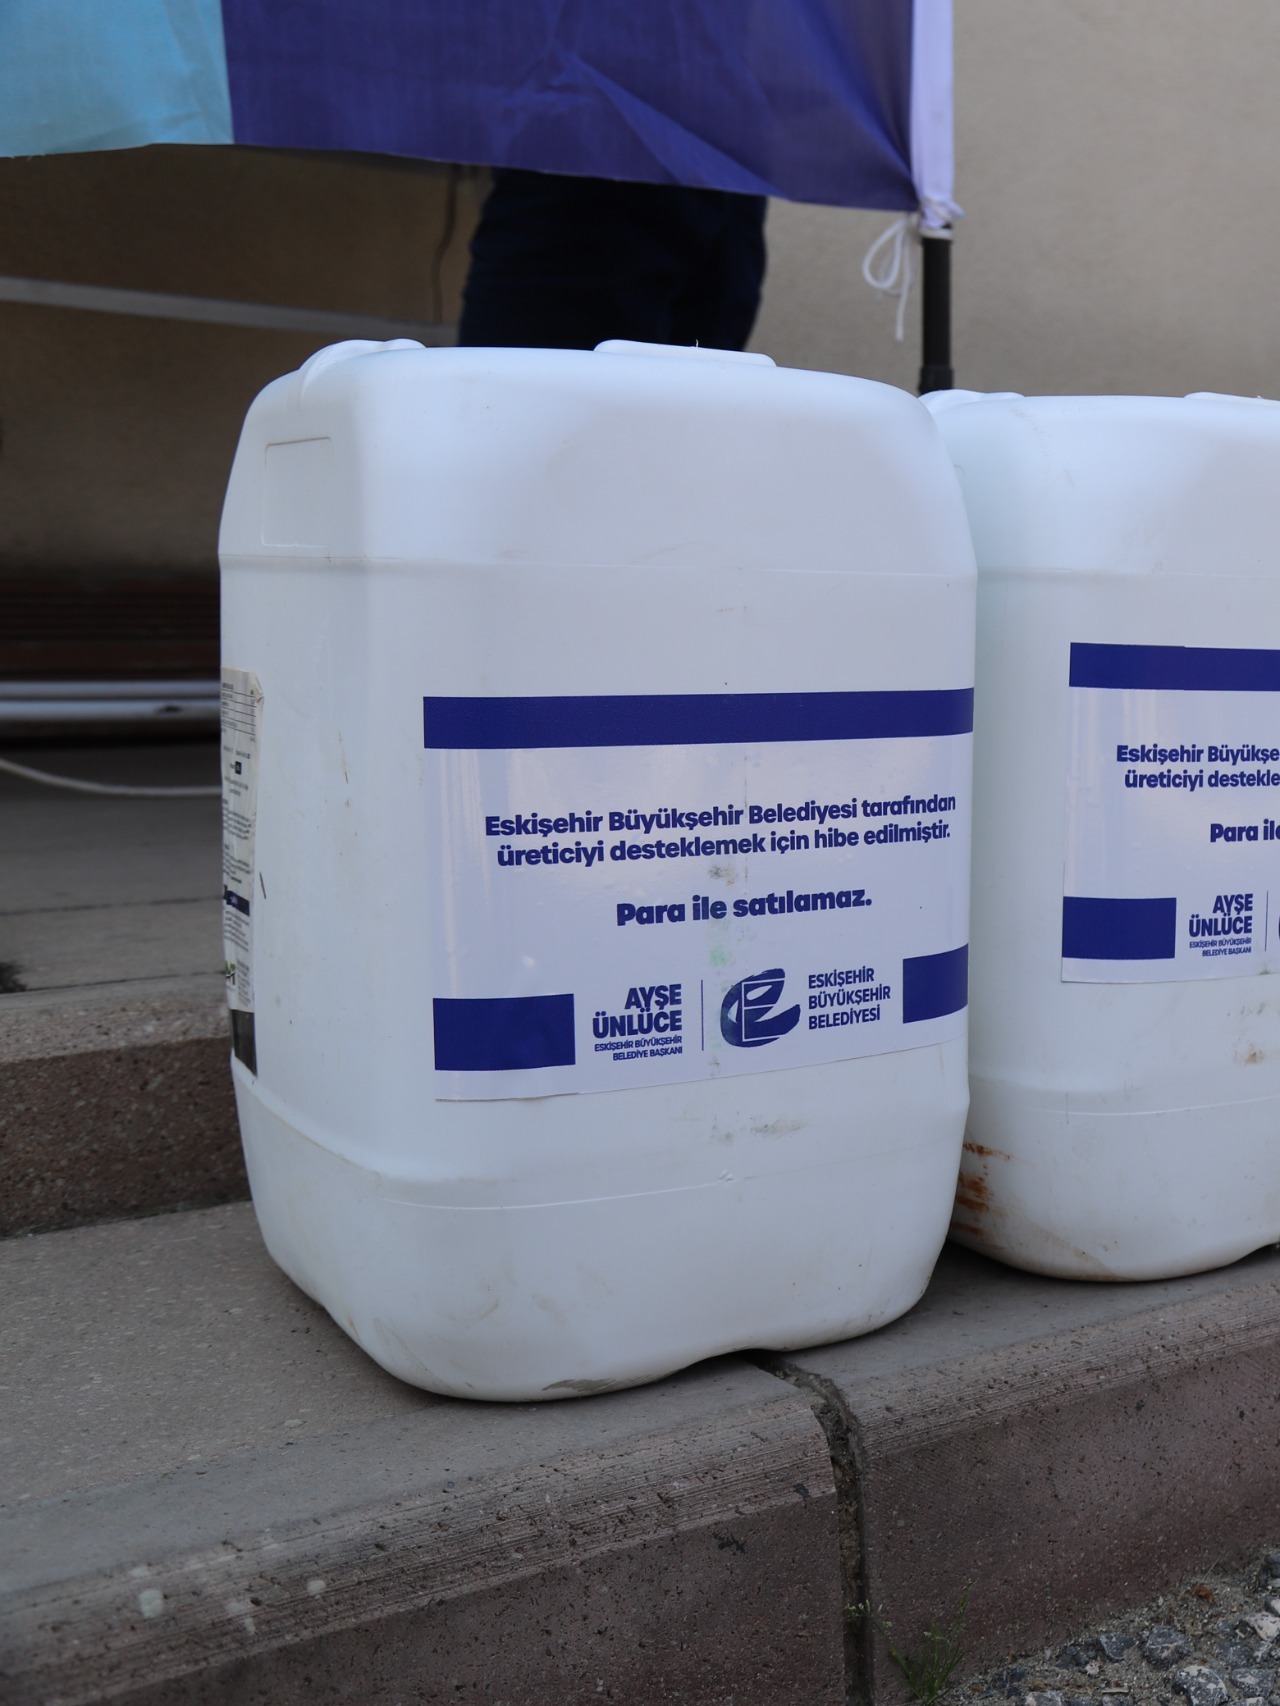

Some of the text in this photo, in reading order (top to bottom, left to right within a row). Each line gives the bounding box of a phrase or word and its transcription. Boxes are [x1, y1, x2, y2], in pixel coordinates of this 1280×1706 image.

[1117, 744, 1203, 764] Eskişehir
[1125, 769, 1203, 791] üreticiyi
[485, 794, 956, 837] Eskişehir Büyükşehir Belediyesi tarafından
[497, 820, 951, 867] üreticiyi desteklemek için hibe edilmiştir.
[1210, 823, 1258, 842] Para
[616, 887, 872, 926] Para ile satılamaz.
[1213, 893, 1253, 915] AYŞE
[1189, 913, 1252, 937] ÜNLÜCE
[1190, 937, 1251, 948] ESKİŞEHİR BÜYÜKŞEHİR
[1202, 947, 1251, 957] BELEDİYE BAŞKANI
[808, 968, 874, 989] ESKİŞEHİR
[624, 984, 682, 1010] AYŞE
[808, 985, 891, 1009] BÜYÜKŞEHİR
[592, 1007, 682, 1038] ÜNLÜCE
[808, 1004, 880, 1030] BELEDİYESİ
[594, 1034, 682, 1052] ESKİŞEHİR BÜYÜKŞEHİR
[613, 1046, 683, 1061] BELEDİYE BAŞKANI
